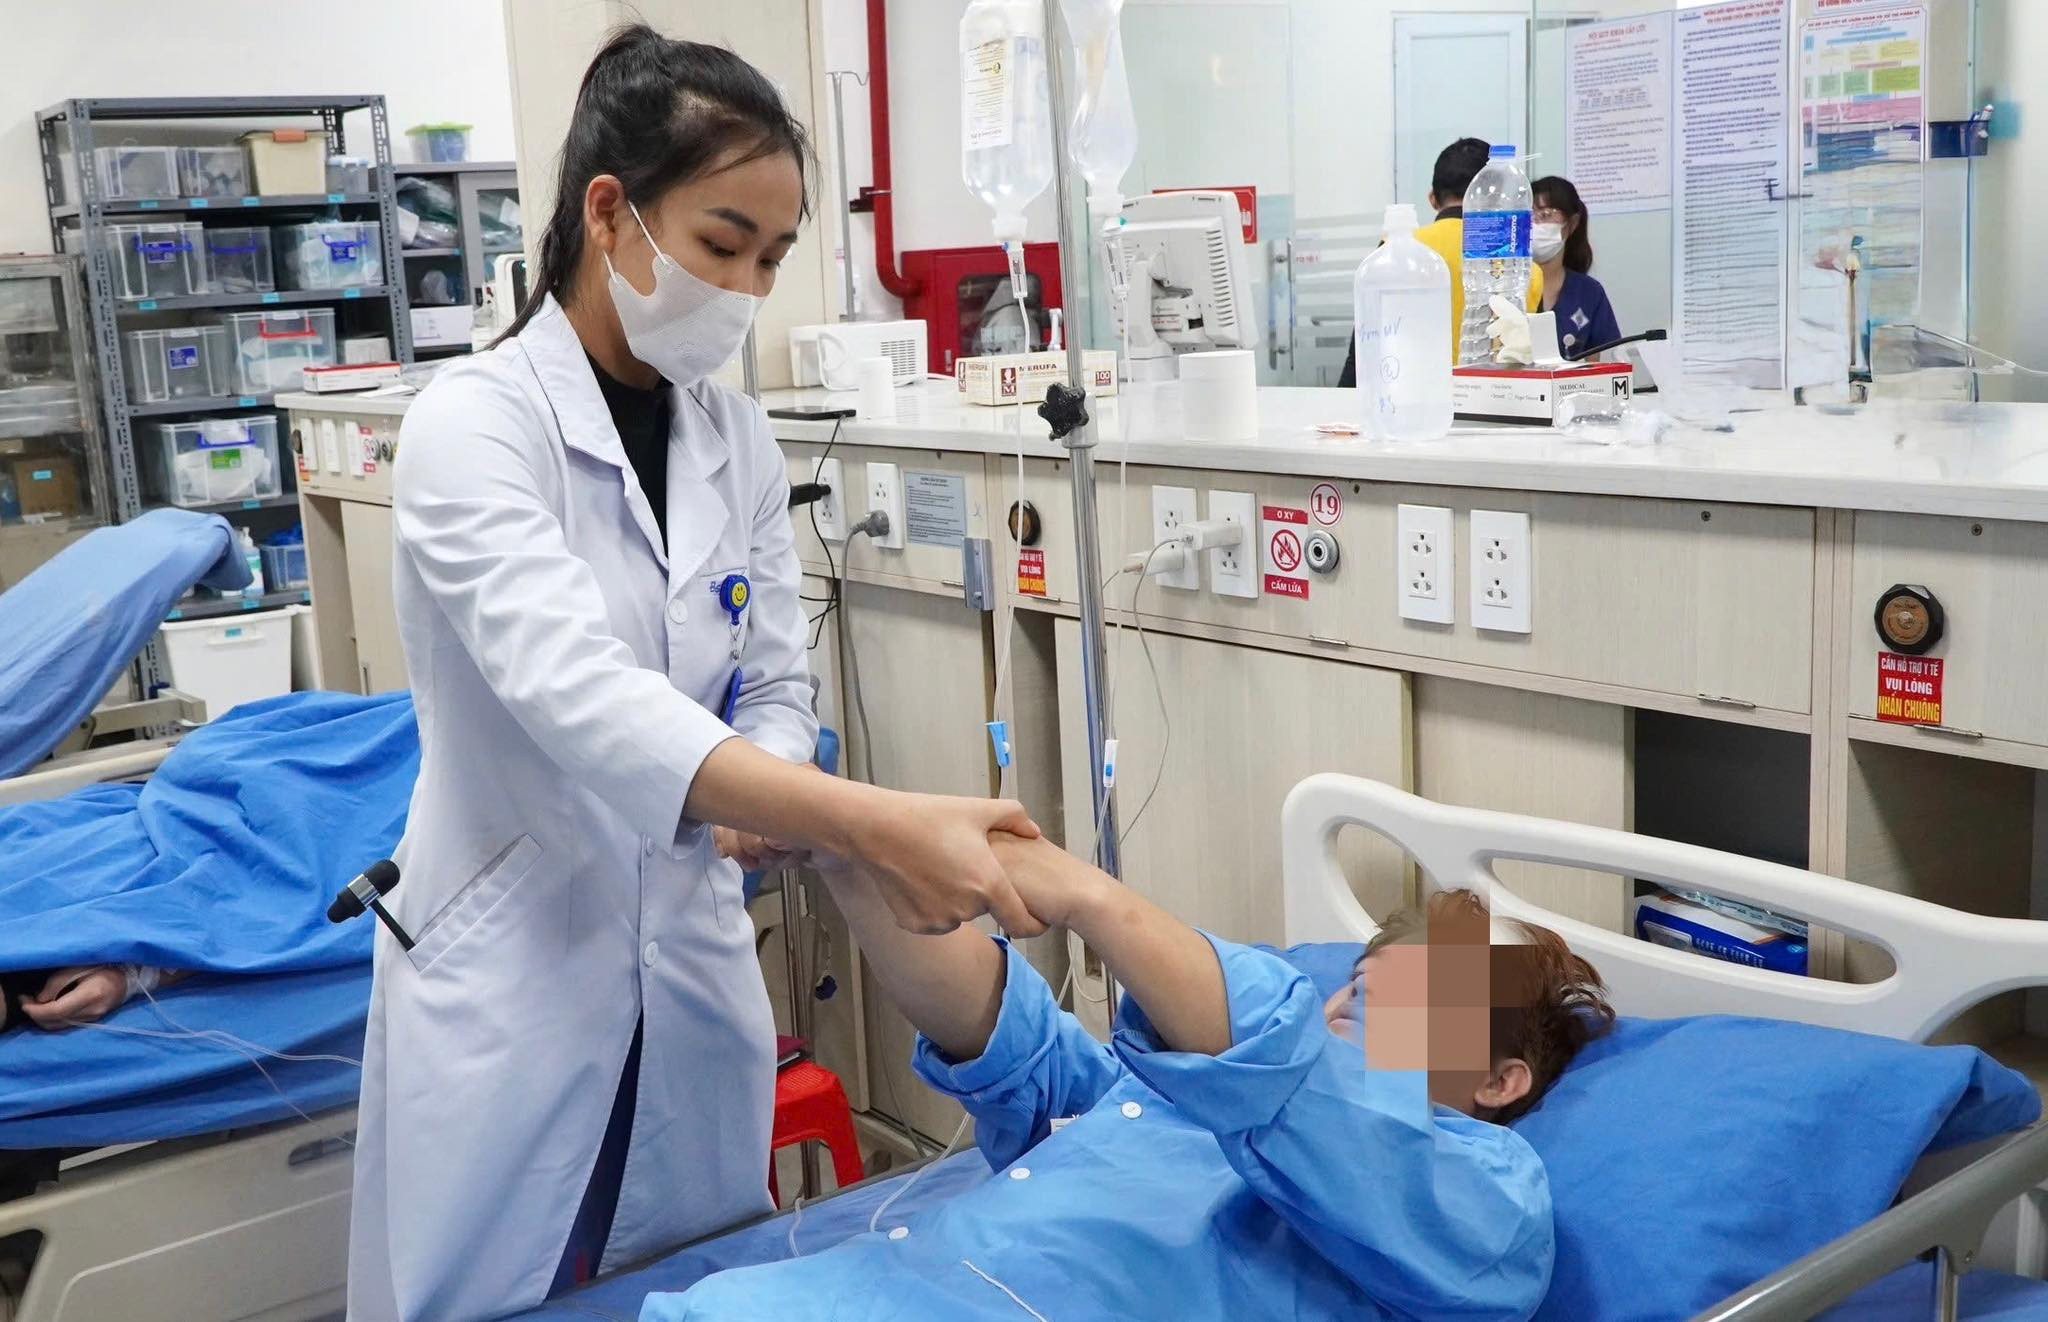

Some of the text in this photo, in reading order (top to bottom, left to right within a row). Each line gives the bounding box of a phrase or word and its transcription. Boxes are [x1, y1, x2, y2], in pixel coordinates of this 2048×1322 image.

[1096, 371, 1110, 380] 100
[1003, 385, 1015, 393] M
[1614, 380, 1627, 396] M
[1314, 493, 1339, 516] 19
[1284, 511, 1294, 520] XY
[1923, 663, 1929, 676] Y
[1885, 677, 1933, 695] VUI LÒNG
